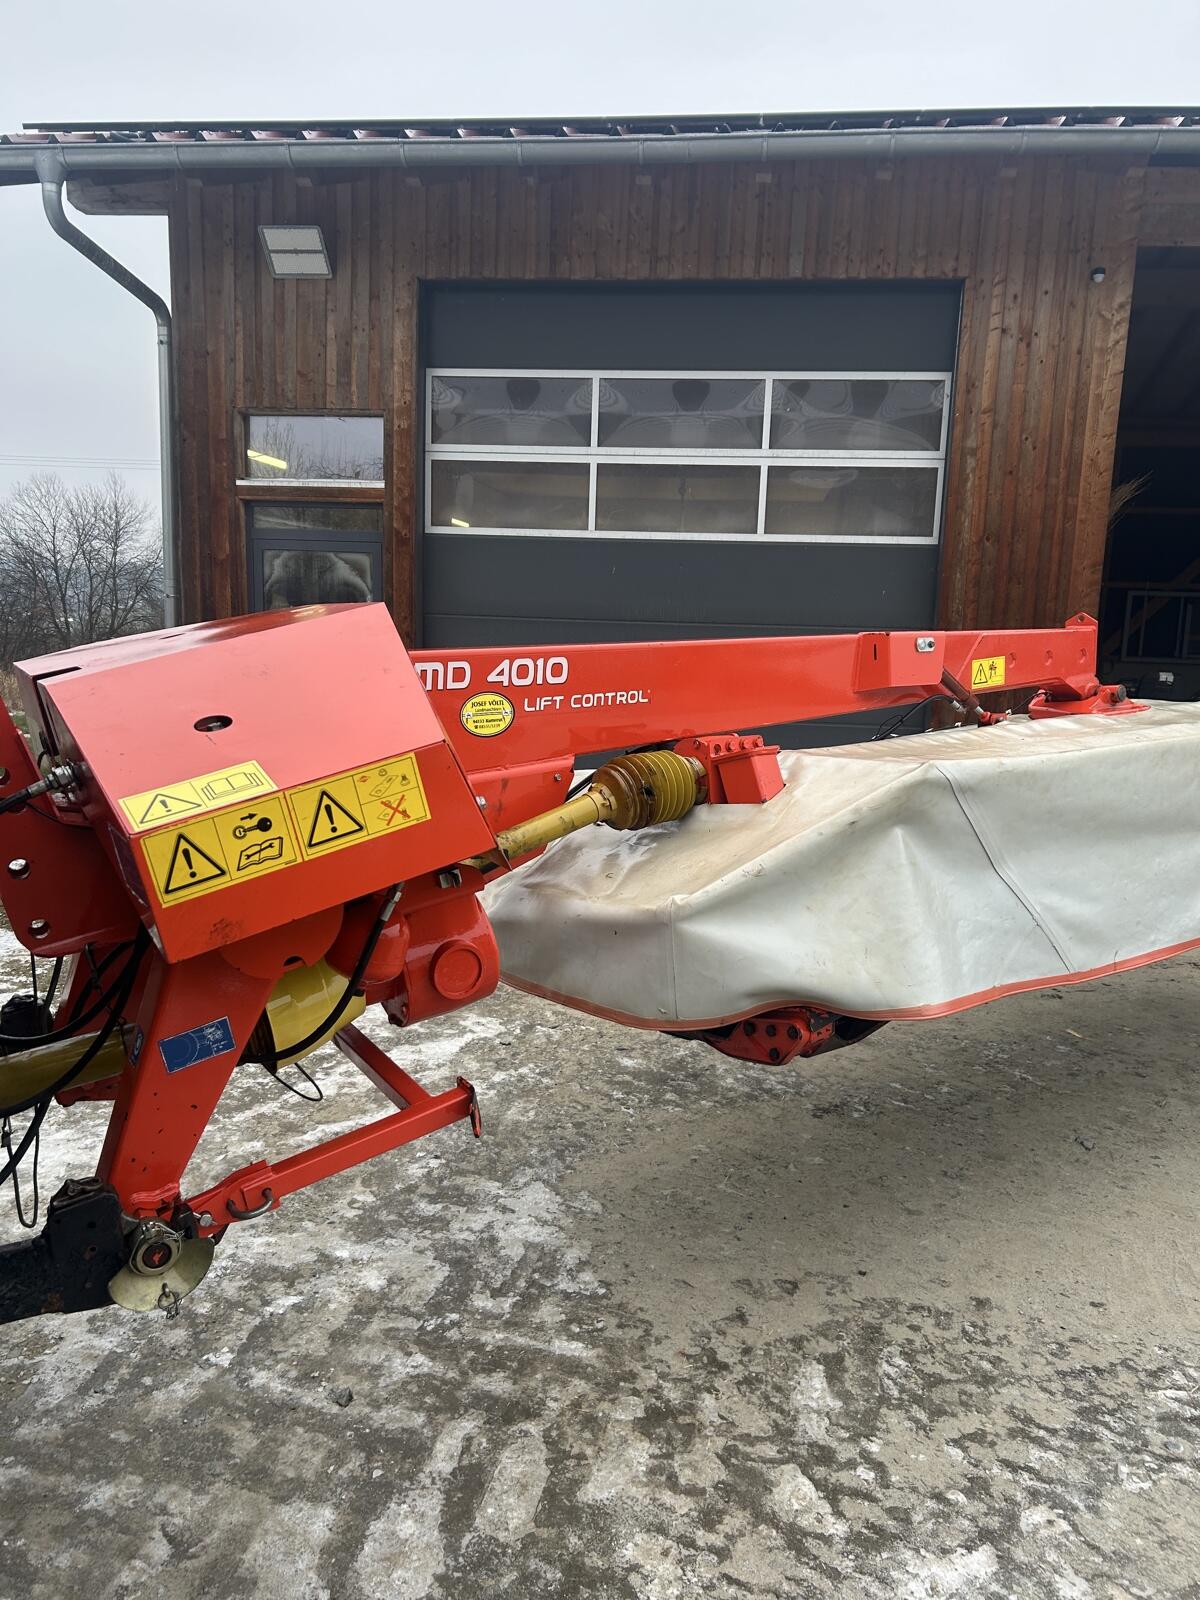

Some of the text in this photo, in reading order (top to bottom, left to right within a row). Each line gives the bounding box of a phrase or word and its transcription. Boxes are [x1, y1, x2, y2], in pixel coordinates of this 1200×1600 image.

[487, 657, 568, 686] 4010
[524, 690, 648, 711] LIFT CONTROL
